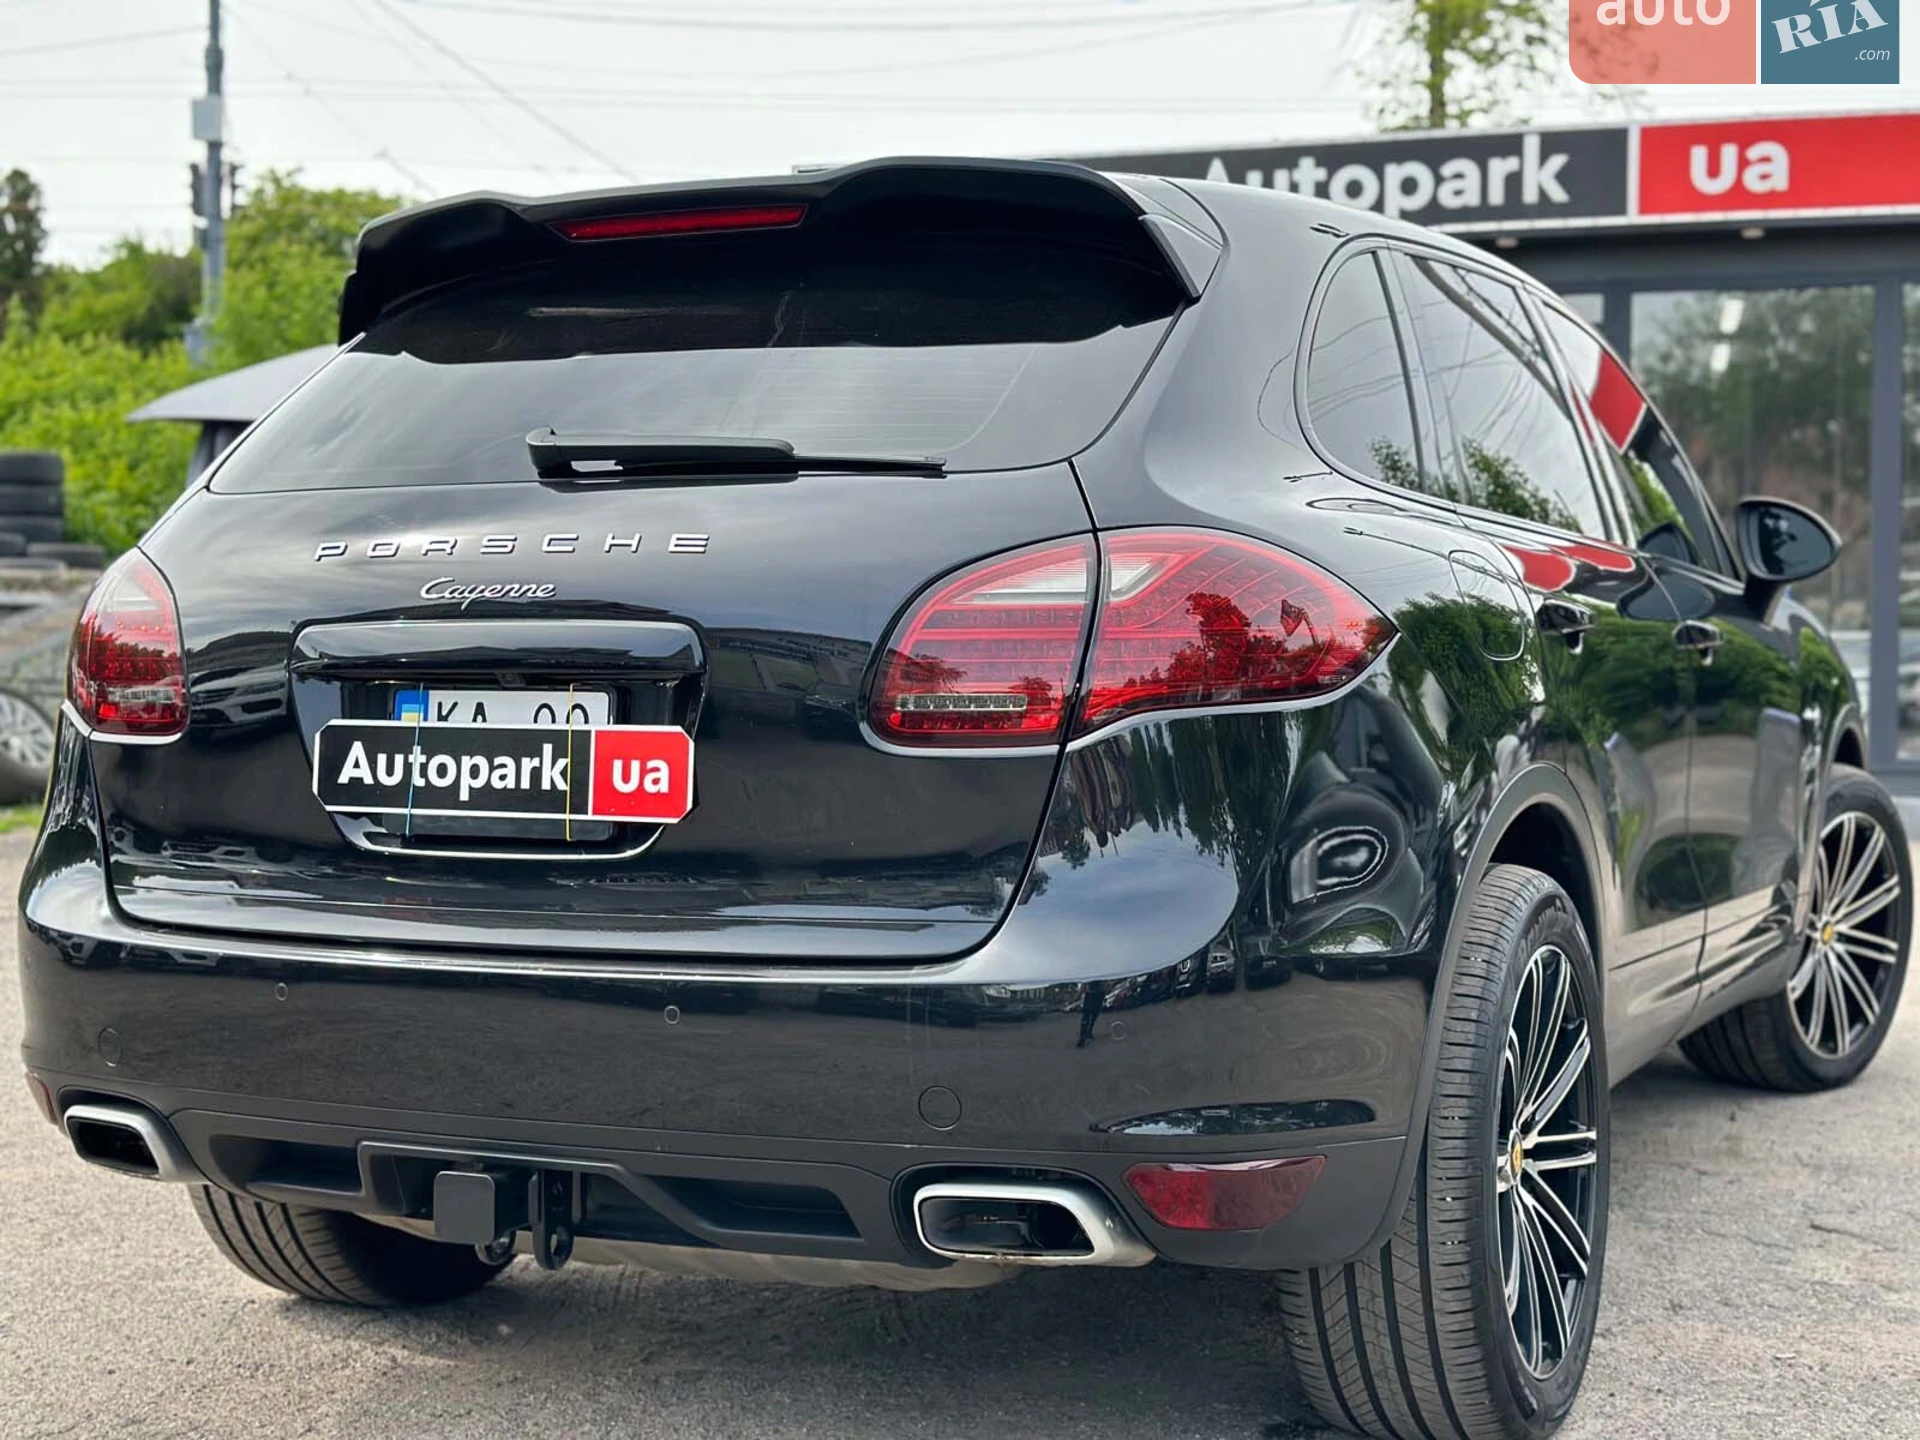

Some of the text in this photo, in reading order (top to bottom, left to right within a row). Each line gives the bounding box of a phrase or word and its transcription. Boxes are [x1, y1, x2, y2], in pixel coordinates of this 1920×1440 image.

[1689, 140, 1790, 196] ua
[314, 532, 710, 561] PORSCHE
[419, 576, 557, 611] Cayenne
[337, 740, 671, 801] Autopark ua
